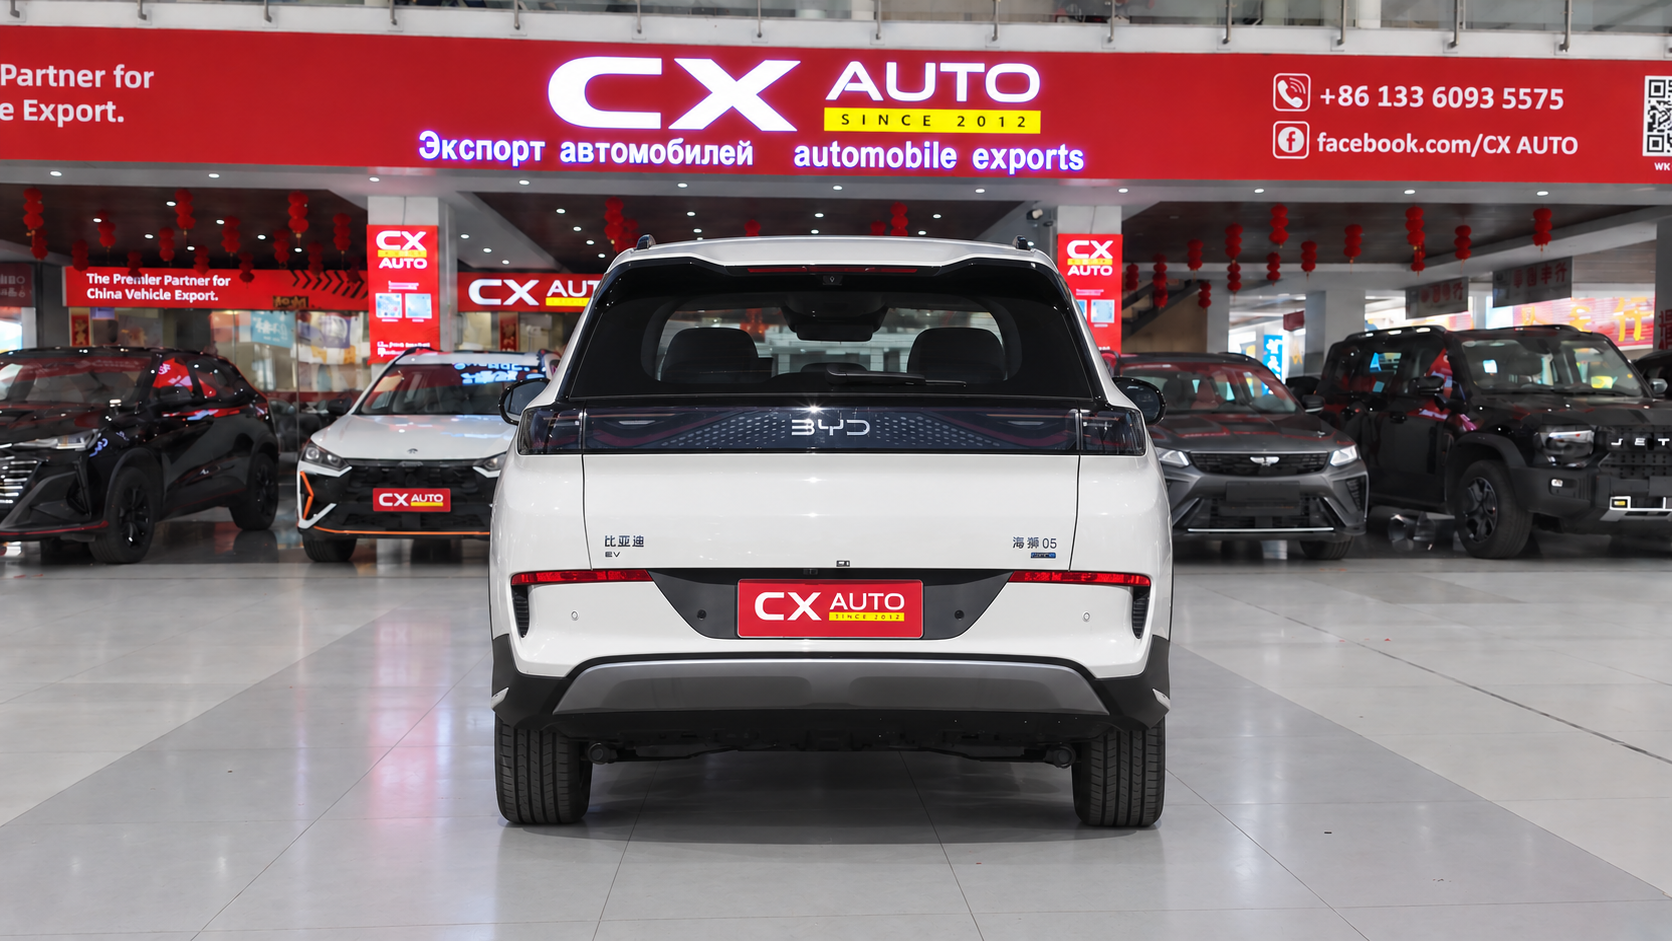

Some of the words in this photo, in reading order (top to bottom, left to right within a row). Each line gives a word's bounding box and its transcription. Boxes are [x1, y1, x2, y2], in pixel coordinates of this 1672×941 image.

[1, 63, 106, 88] Partner
[113, 64, 155, 89] for
[547, 56, 801, 132] CX
[825, 61, 1041, 103] AUTO
[1320, 85, 1370, 107] +86
[1378, 85, 1424, 108] 133
[1432, 86, 1495, 109] 6093
[1502, 87, 1564, 110] 5575
[23, 99, 125, 128] Export.
[841, 113, 931, 127] SINCE
[957, 115, 1026, 128] 2012
[418, 130, 546, 168] Экспорт
[559, 137, 754, 166] автомобилей
[1317, 132, 1511, 158] facebook.com/CX
[1516, 136, 1578, 155] AUTO
[794, 140, 958, 169] automobile
[972, 143, 1084, 175] exports
[376, 230, 427, 251] CX
[1066, 239, 1114, 259] CX
[379, 257, 428, 270] AUTO
[1067, 265, 1113, 276] AUTO
[86, 273, 110, 285] The
[164, 275, 210, 286] Partner
[212, 275, 231, 287] for
[86, 288, 122, 300] China
[125, 289, 171, 300] Vehicle
[174, 290, 219, 303] Export.
[468, 278, 540, 306] CX
[791, 419, 870, 436] BYD
[378, 493, 409, 507] CX
[411, 493, 444, 502] AUTO
[604, 535, 645, 548] 比亚迪
[754, 591, 822, 621] CX
[829, 593, 905, 611] AUTO
